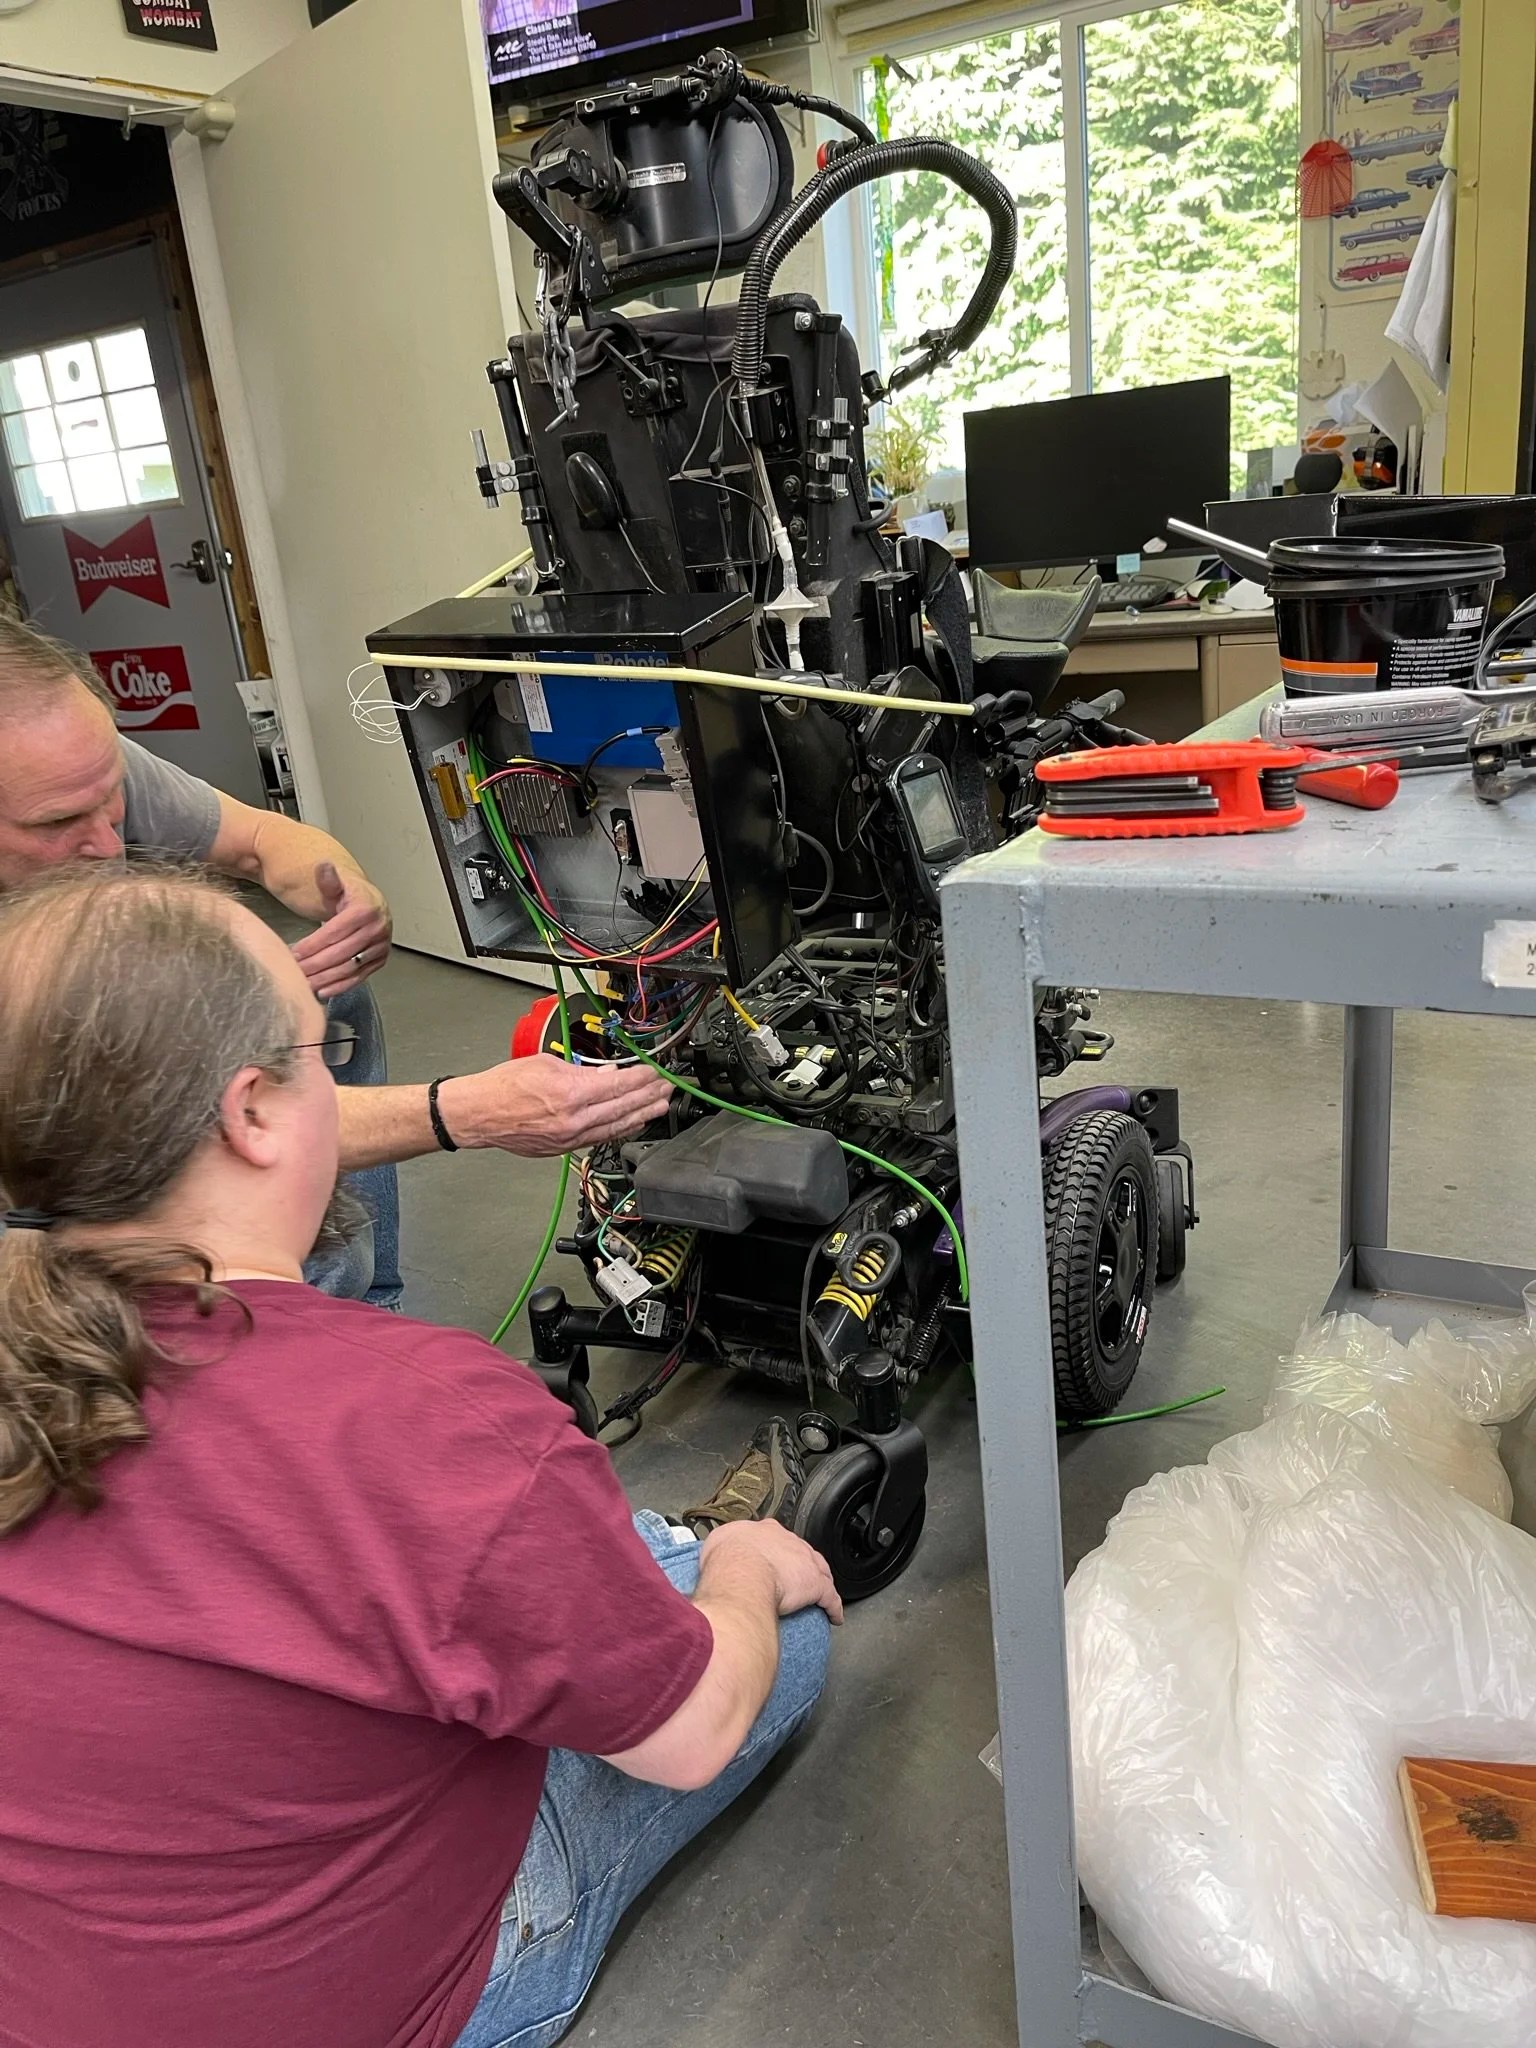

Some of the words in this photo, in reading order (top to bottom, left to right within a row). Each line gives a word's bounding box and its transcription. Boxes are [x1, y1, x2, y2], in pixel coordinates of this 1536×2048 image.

[141, 9, 202, 29] WOMBAT
[525, 22, 552, 36] Classic
[552, 15, 572, 29] Rock
[75, 554, 157, 582] Budweiser
[1453, 606, 1484, 622] YAMALUBE
[595, 653, 669, 668] Robote
[111, 660, 172, 699] Coke
[1370, 711, 1384, 722] IN
[1391, 707, 1444, 722] FORGED
